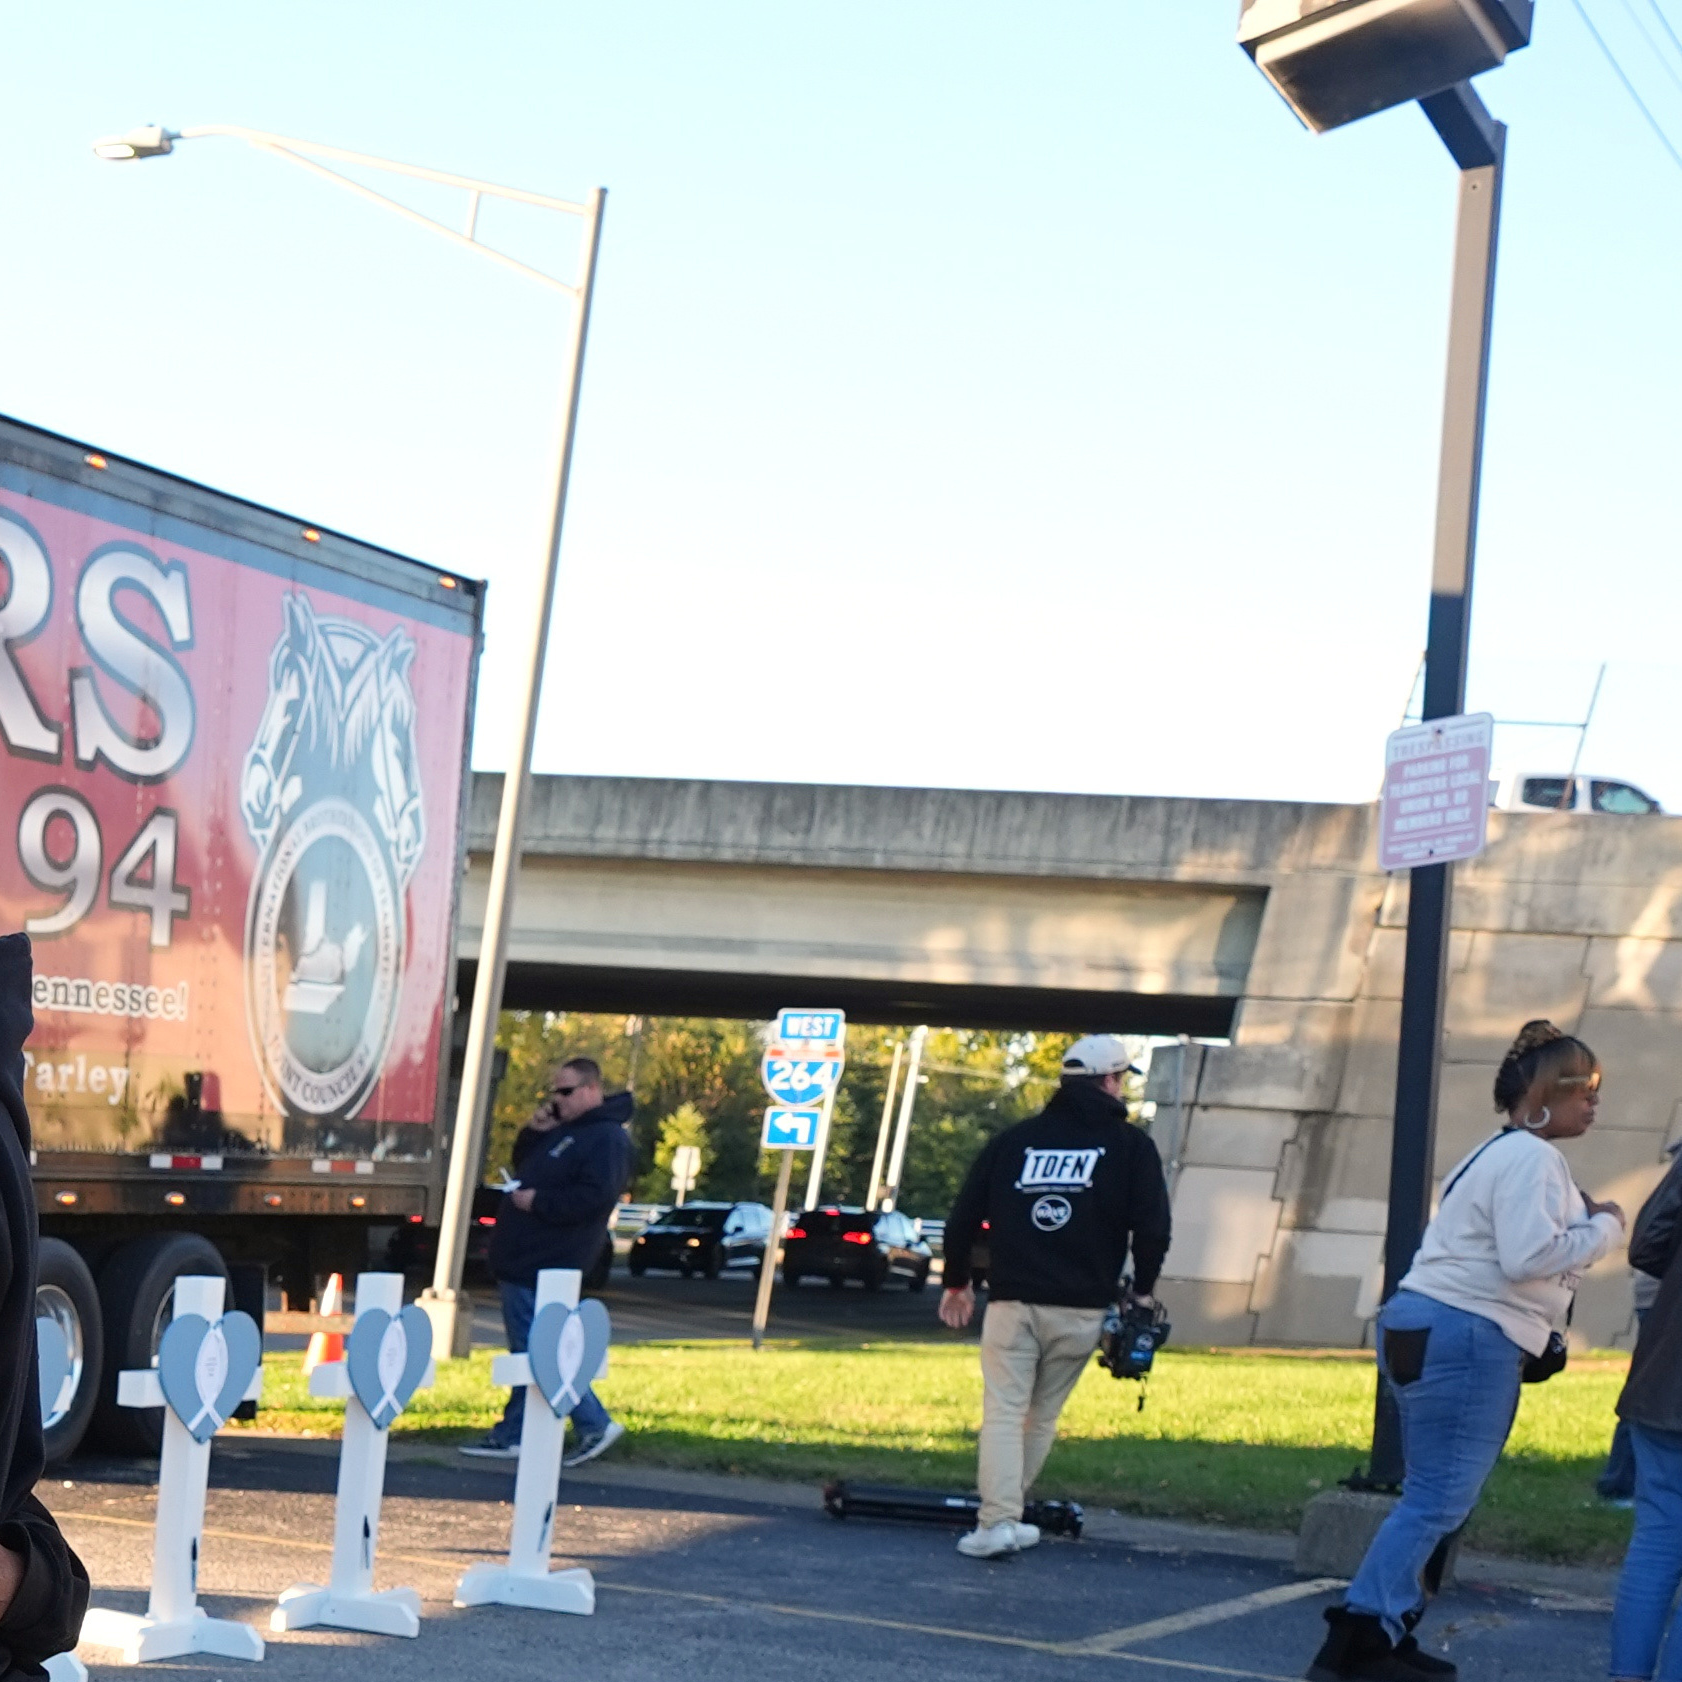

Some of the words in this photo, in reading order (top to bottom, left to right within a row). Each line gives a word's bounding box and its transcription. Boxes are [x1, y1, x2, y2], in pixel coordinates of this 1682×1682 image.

[17, 789, 192, 948] 94
[32, 974, 189, 1022] ennessee!
[786, 1015, 836, 1037] WEST
[770, 1060, 836, 1090] 264
